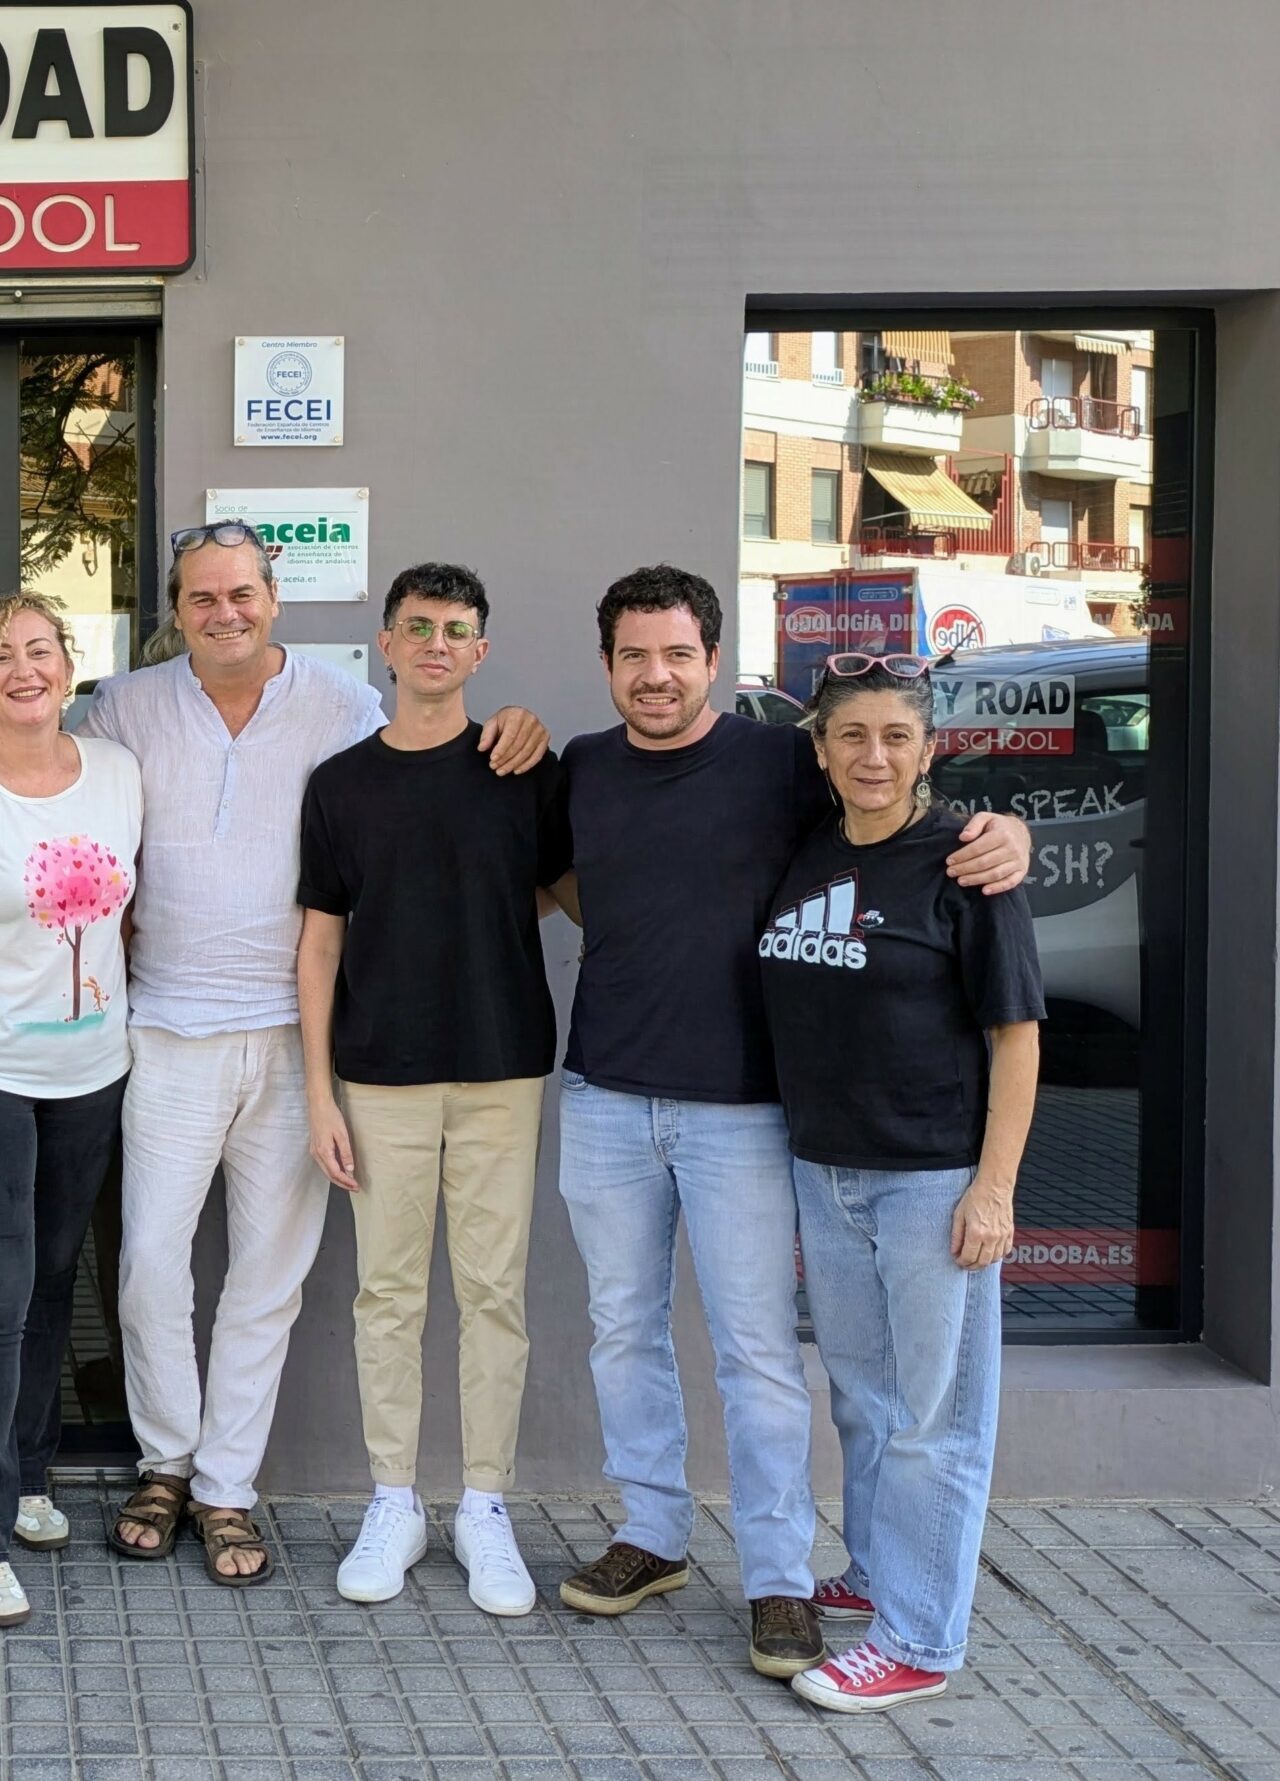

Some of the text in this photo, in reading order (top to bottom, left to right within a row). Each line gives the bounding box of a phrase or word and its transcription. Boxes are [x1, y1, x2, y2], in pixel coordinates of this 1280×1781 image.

[276, 370, 302, 378] FECEI
[247, 399, 331, 421] FECEI
[260, 433, 318, 441] www.fecei.org
[214, 504, 248, 512] Socio de
[255, 517, 351, 544] aceia
[975, 680, 1070, 716] ROAD
[957, 730, 1060, 750] SCHOOL
[1010, 781, 1126, 822] SPEAK
[758, 927, 868, 970] adidas
